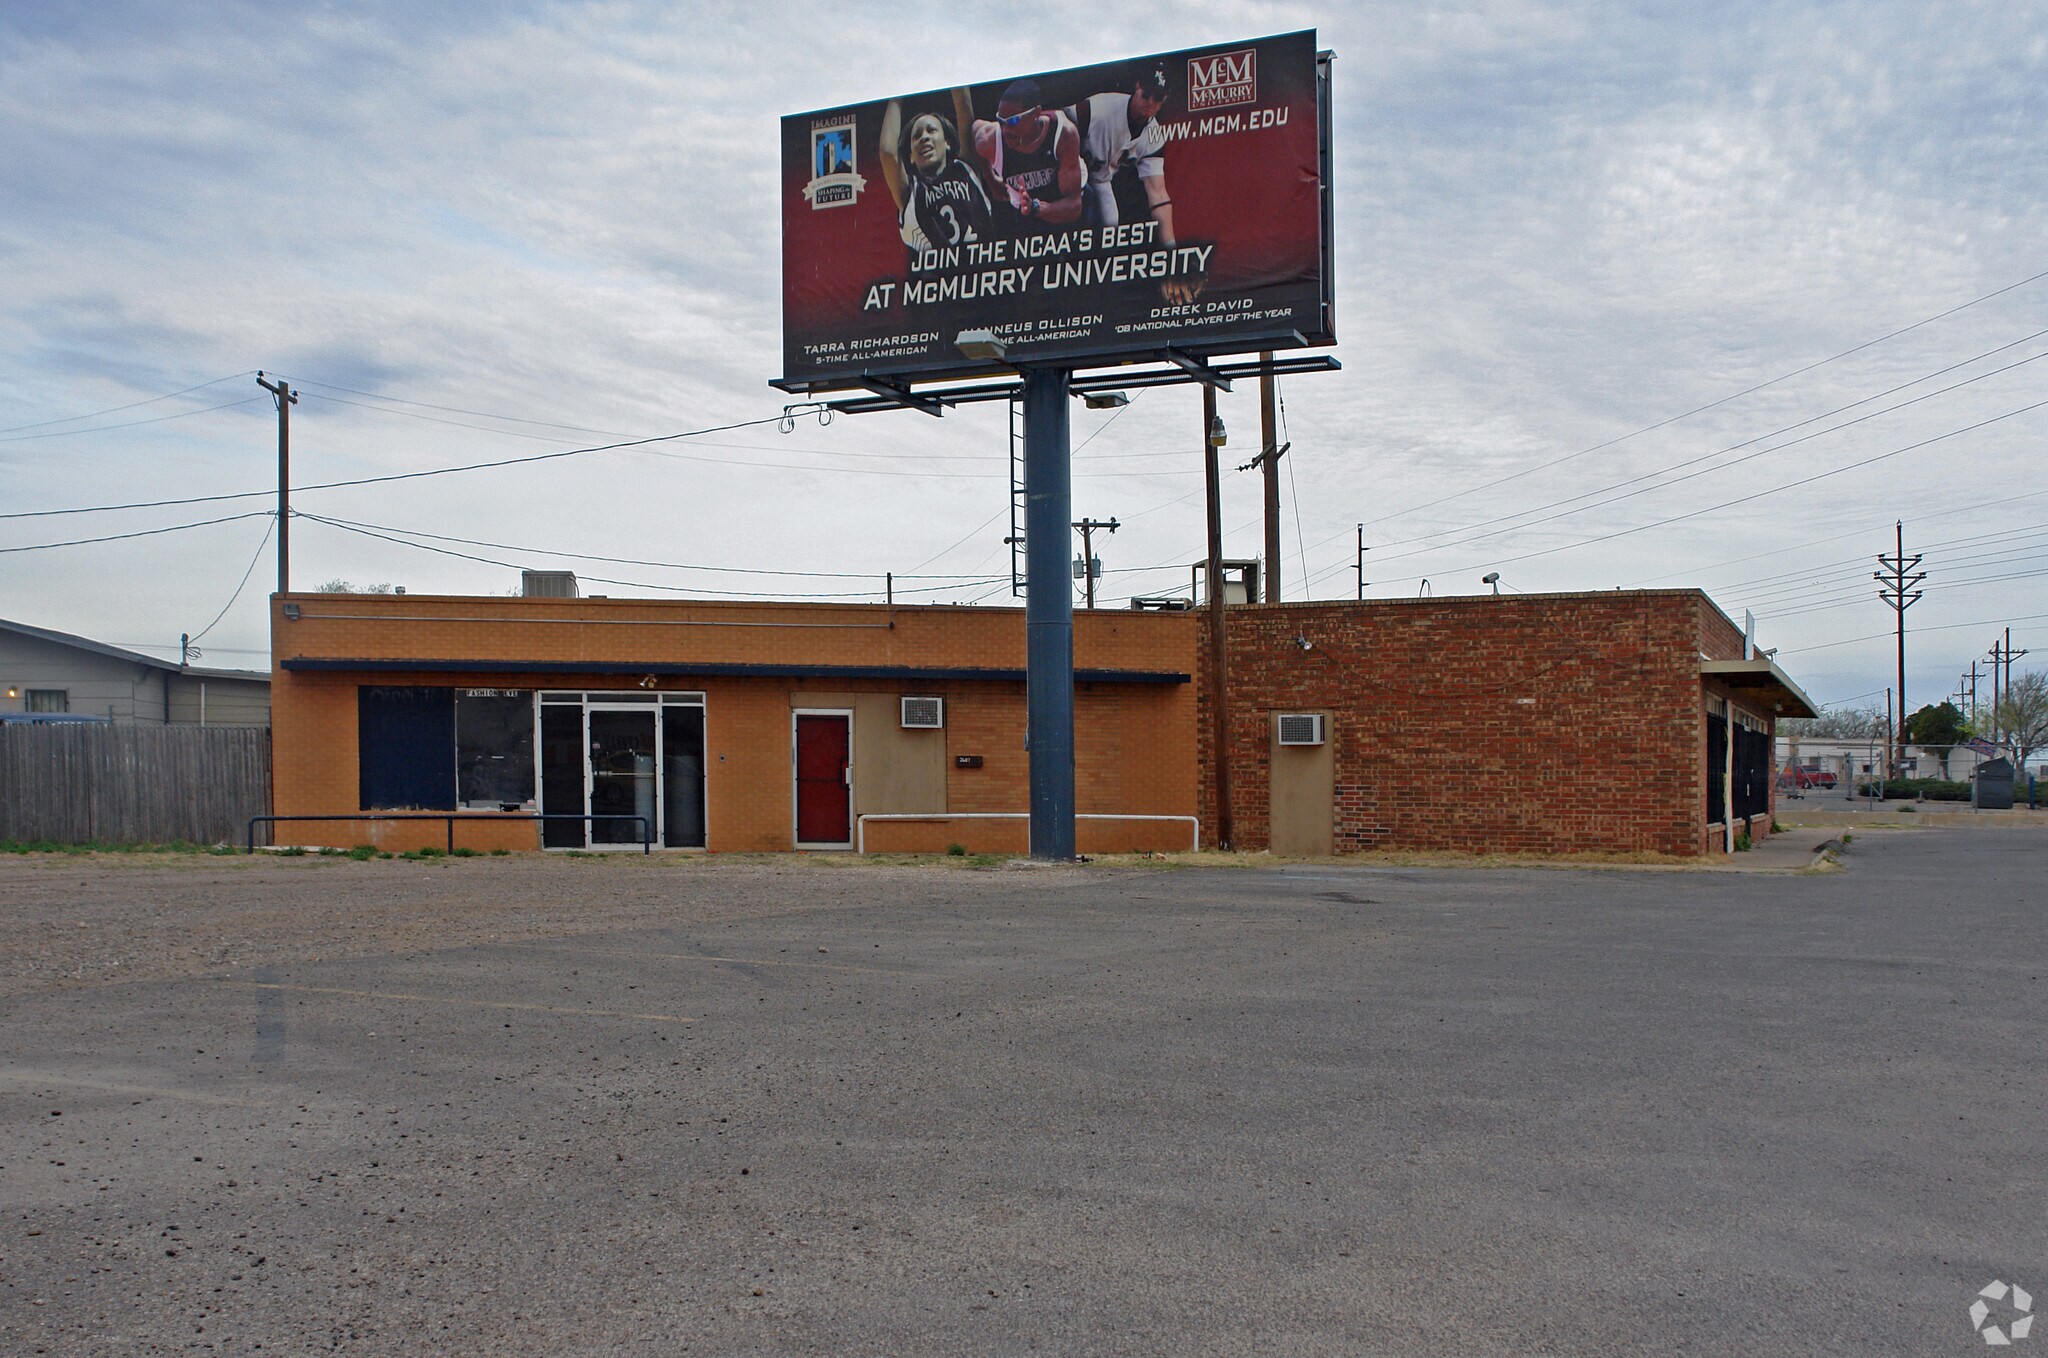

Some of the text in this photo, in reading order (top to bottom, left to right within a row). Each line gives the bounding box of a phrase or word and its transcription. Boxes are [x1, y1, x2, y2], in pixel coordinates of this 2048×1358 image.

[811, 114, 857, 129] IMAGINE
[1148, 106, 1289, 144] WWW.MCM.EDU
[911, 221, 1159, 272] JOIN THE NCAA'S BEST
[863, 283, 896, 310] AT
[1043, 245, 1213, 290] UNIVERSITY
[1150, 298, 1254, 318] DEREK DAVID
[1038, 314, 1103, 330] OLLISON
[1133, 317, 1183, 332] NATIONAL
[1184, 315, 1223, 327] PLAYER
[1225, 313, 1241, 322] OF
[1242, 310, 1263, 320] THE
[1264, 307, 1292, 318] YEAR
[804, 331, 940, 355] TARRA RICHARDSON
[1016, 329, 1091, 344] ALL-AMERICAN
[815, 345, 928, 365] 5-TIME ALL-AMERICAN
